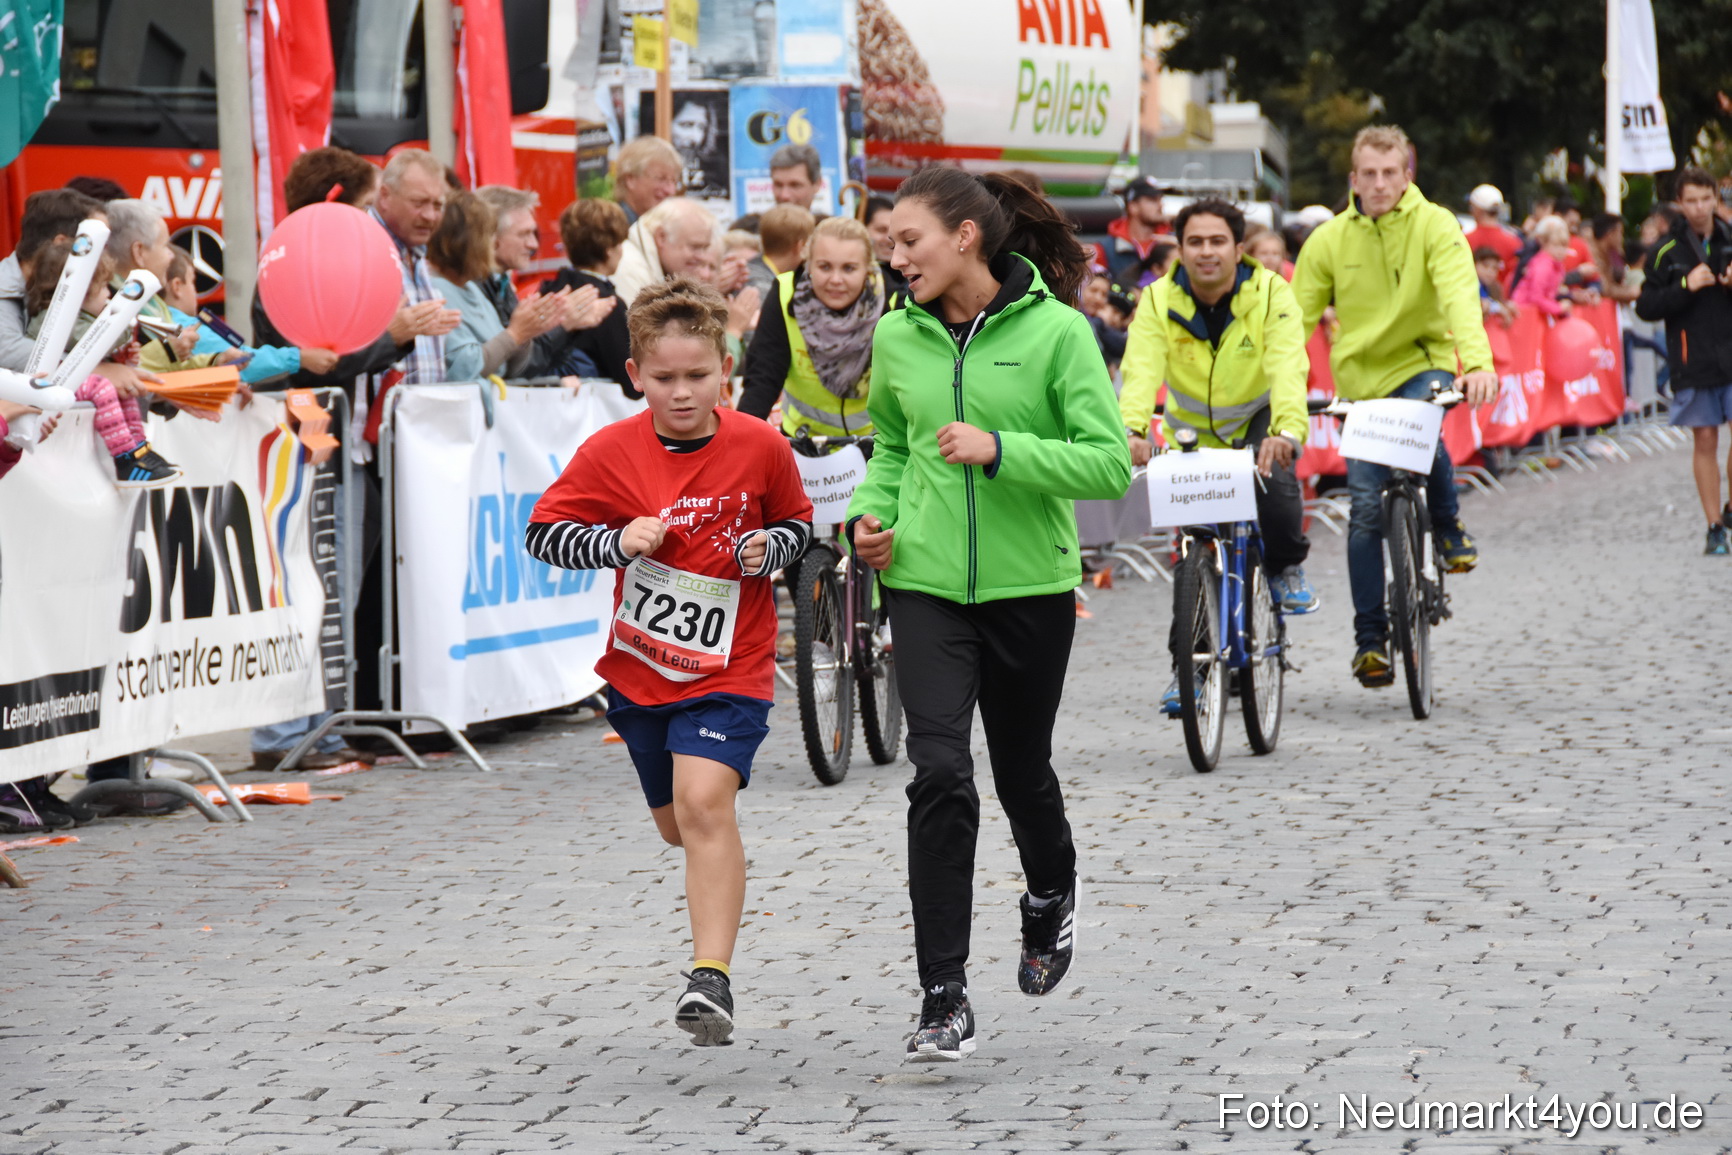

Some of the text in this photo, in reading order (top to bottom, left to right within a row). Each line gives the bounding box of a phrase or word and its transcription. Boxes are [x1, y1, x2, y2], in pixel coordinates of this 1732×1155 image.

[1018, 0, 1110, 49] AVIA
[1009, 58, 1111, 137] Pellets
[746, 107, 812, 146] G6
[1368, 413, 1423, 431] Erste Frau
[1352, 427, 1430, 450] Halbmarathon
[823, 469, 856, 486] Mann
[1171, 471, 1231, 484] Erste Frau
[1170, 487, 1236, 505] Jugendlauf
[635, 565, 670, 586] NeuerMarkt
[676, 574, 732, 598] BOCK
[633, 581, 726, 648] 7230
[633, 634, 700, 671] Ben Leon
[707, 730, 726, 742] JAKO
